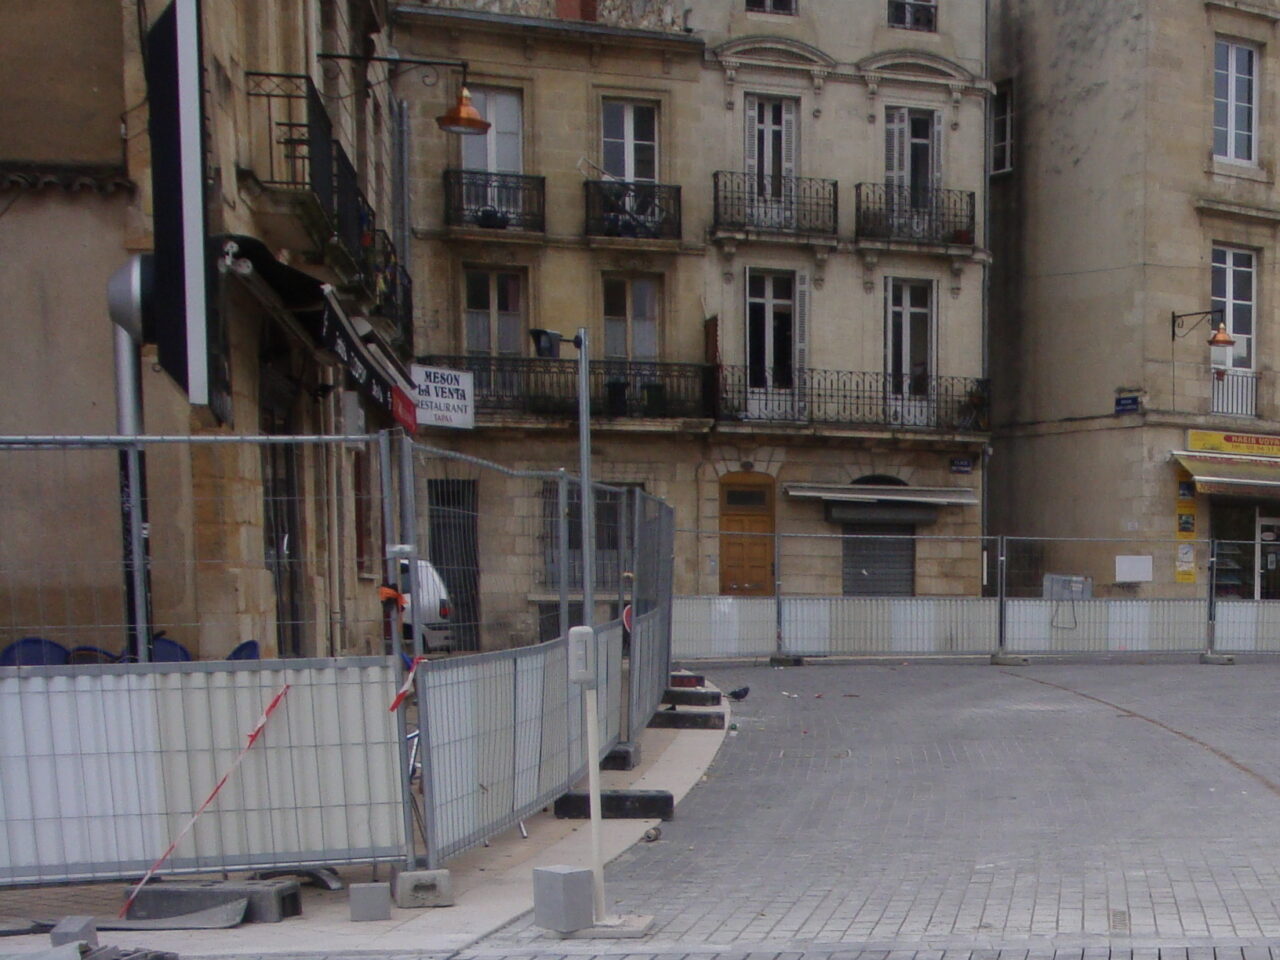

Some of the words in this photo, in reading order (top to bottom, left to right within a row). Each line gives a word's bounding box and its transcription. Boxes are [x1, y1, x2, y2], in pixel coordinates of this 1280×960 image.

[424, 371, 460, 386] MESON
[418, 384, 430, 397] LA
[434, 386, 466, 401] VENTA
[416, 400, 468, 414] RESTAURANT
